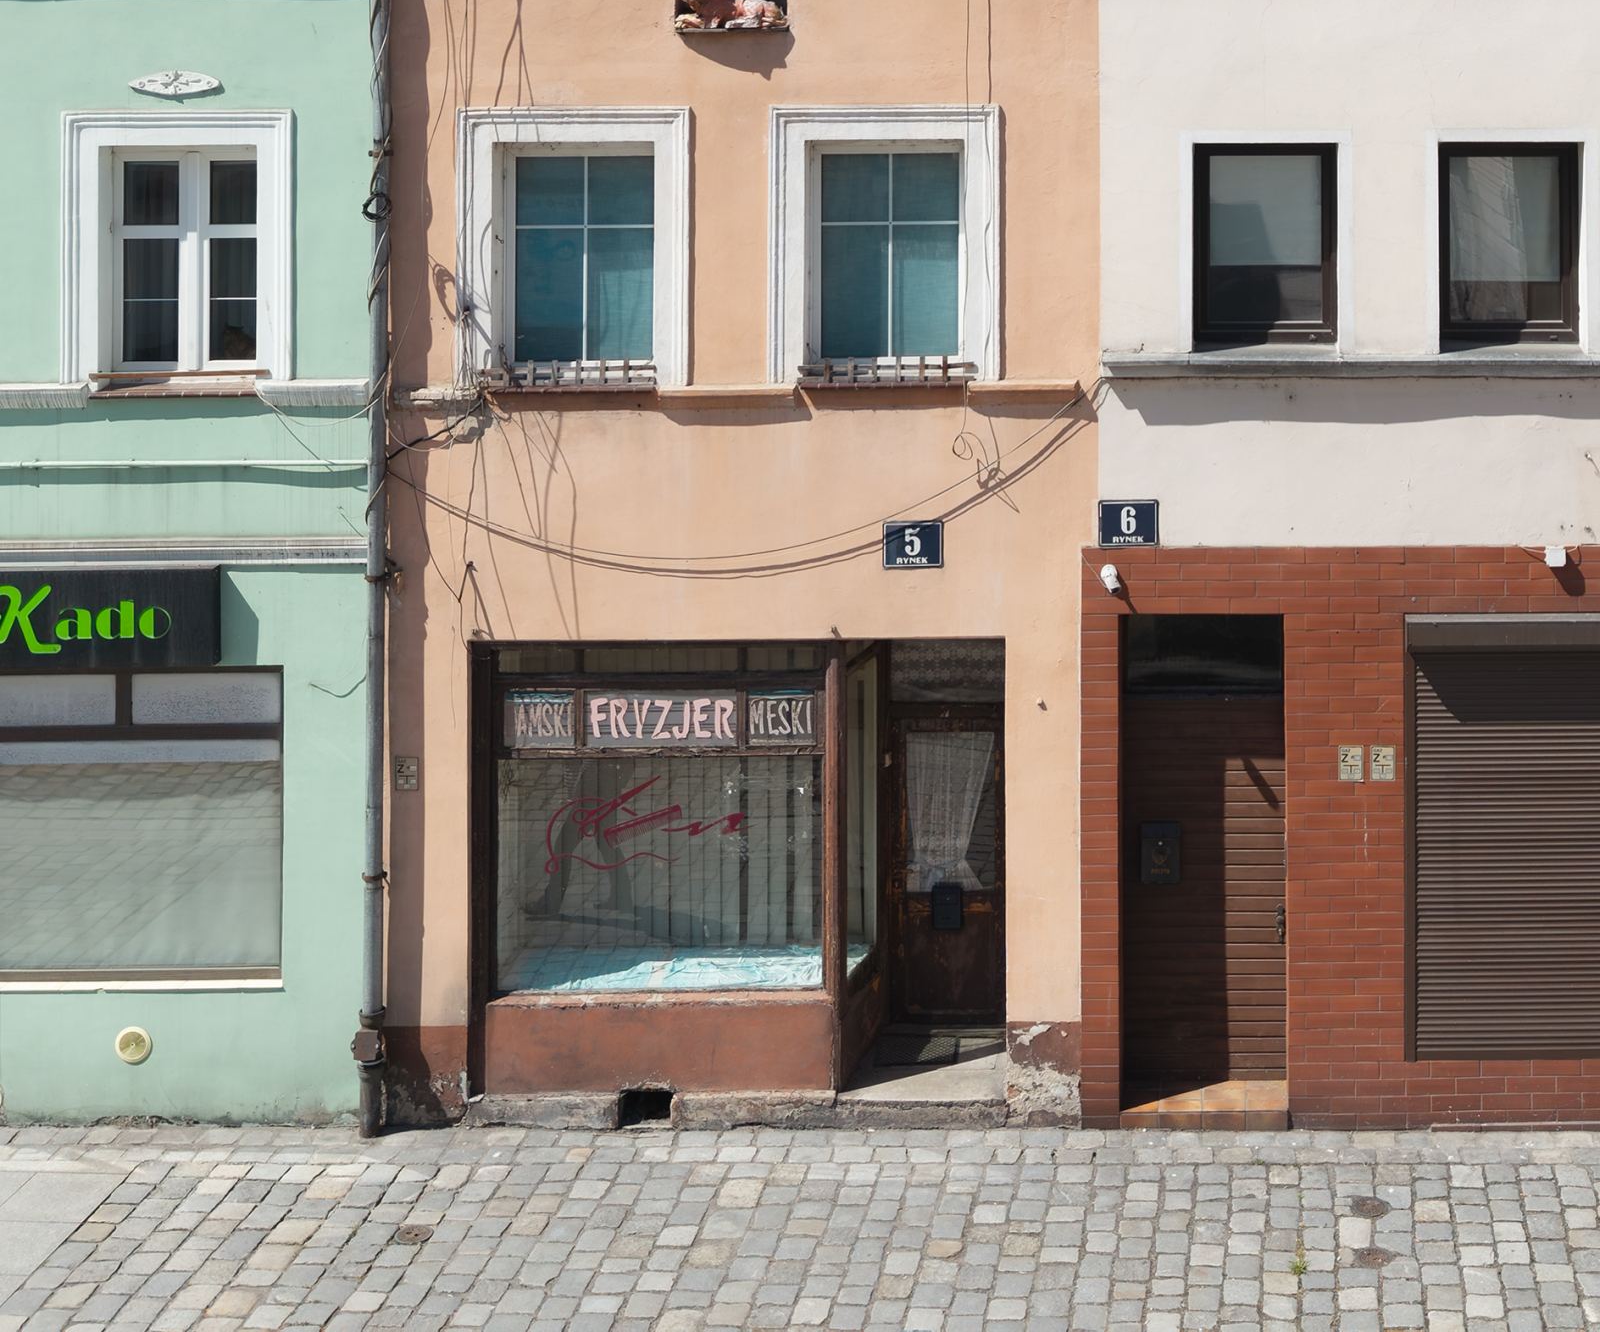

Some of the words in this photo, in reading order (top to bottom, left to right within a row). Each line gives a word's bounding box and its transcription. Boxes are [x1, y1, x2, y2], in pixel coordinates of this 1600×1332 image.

[1121, 506, 1136, 534] 6
[904, 527, 921, 556] 5
[1112, 535, 1144, 543] RYNEK
[896, 556, 928, 564] RYNEK
[0, 585, 172, 654] Kado
[514, 702, 572, 738] AMSKI
[590, 697, 735, 740] FRYZJER
[1341, 753, 1349, 763] Z
[1373, 753, 1380, 763] Z
[397, 764, 405, 773] Z
